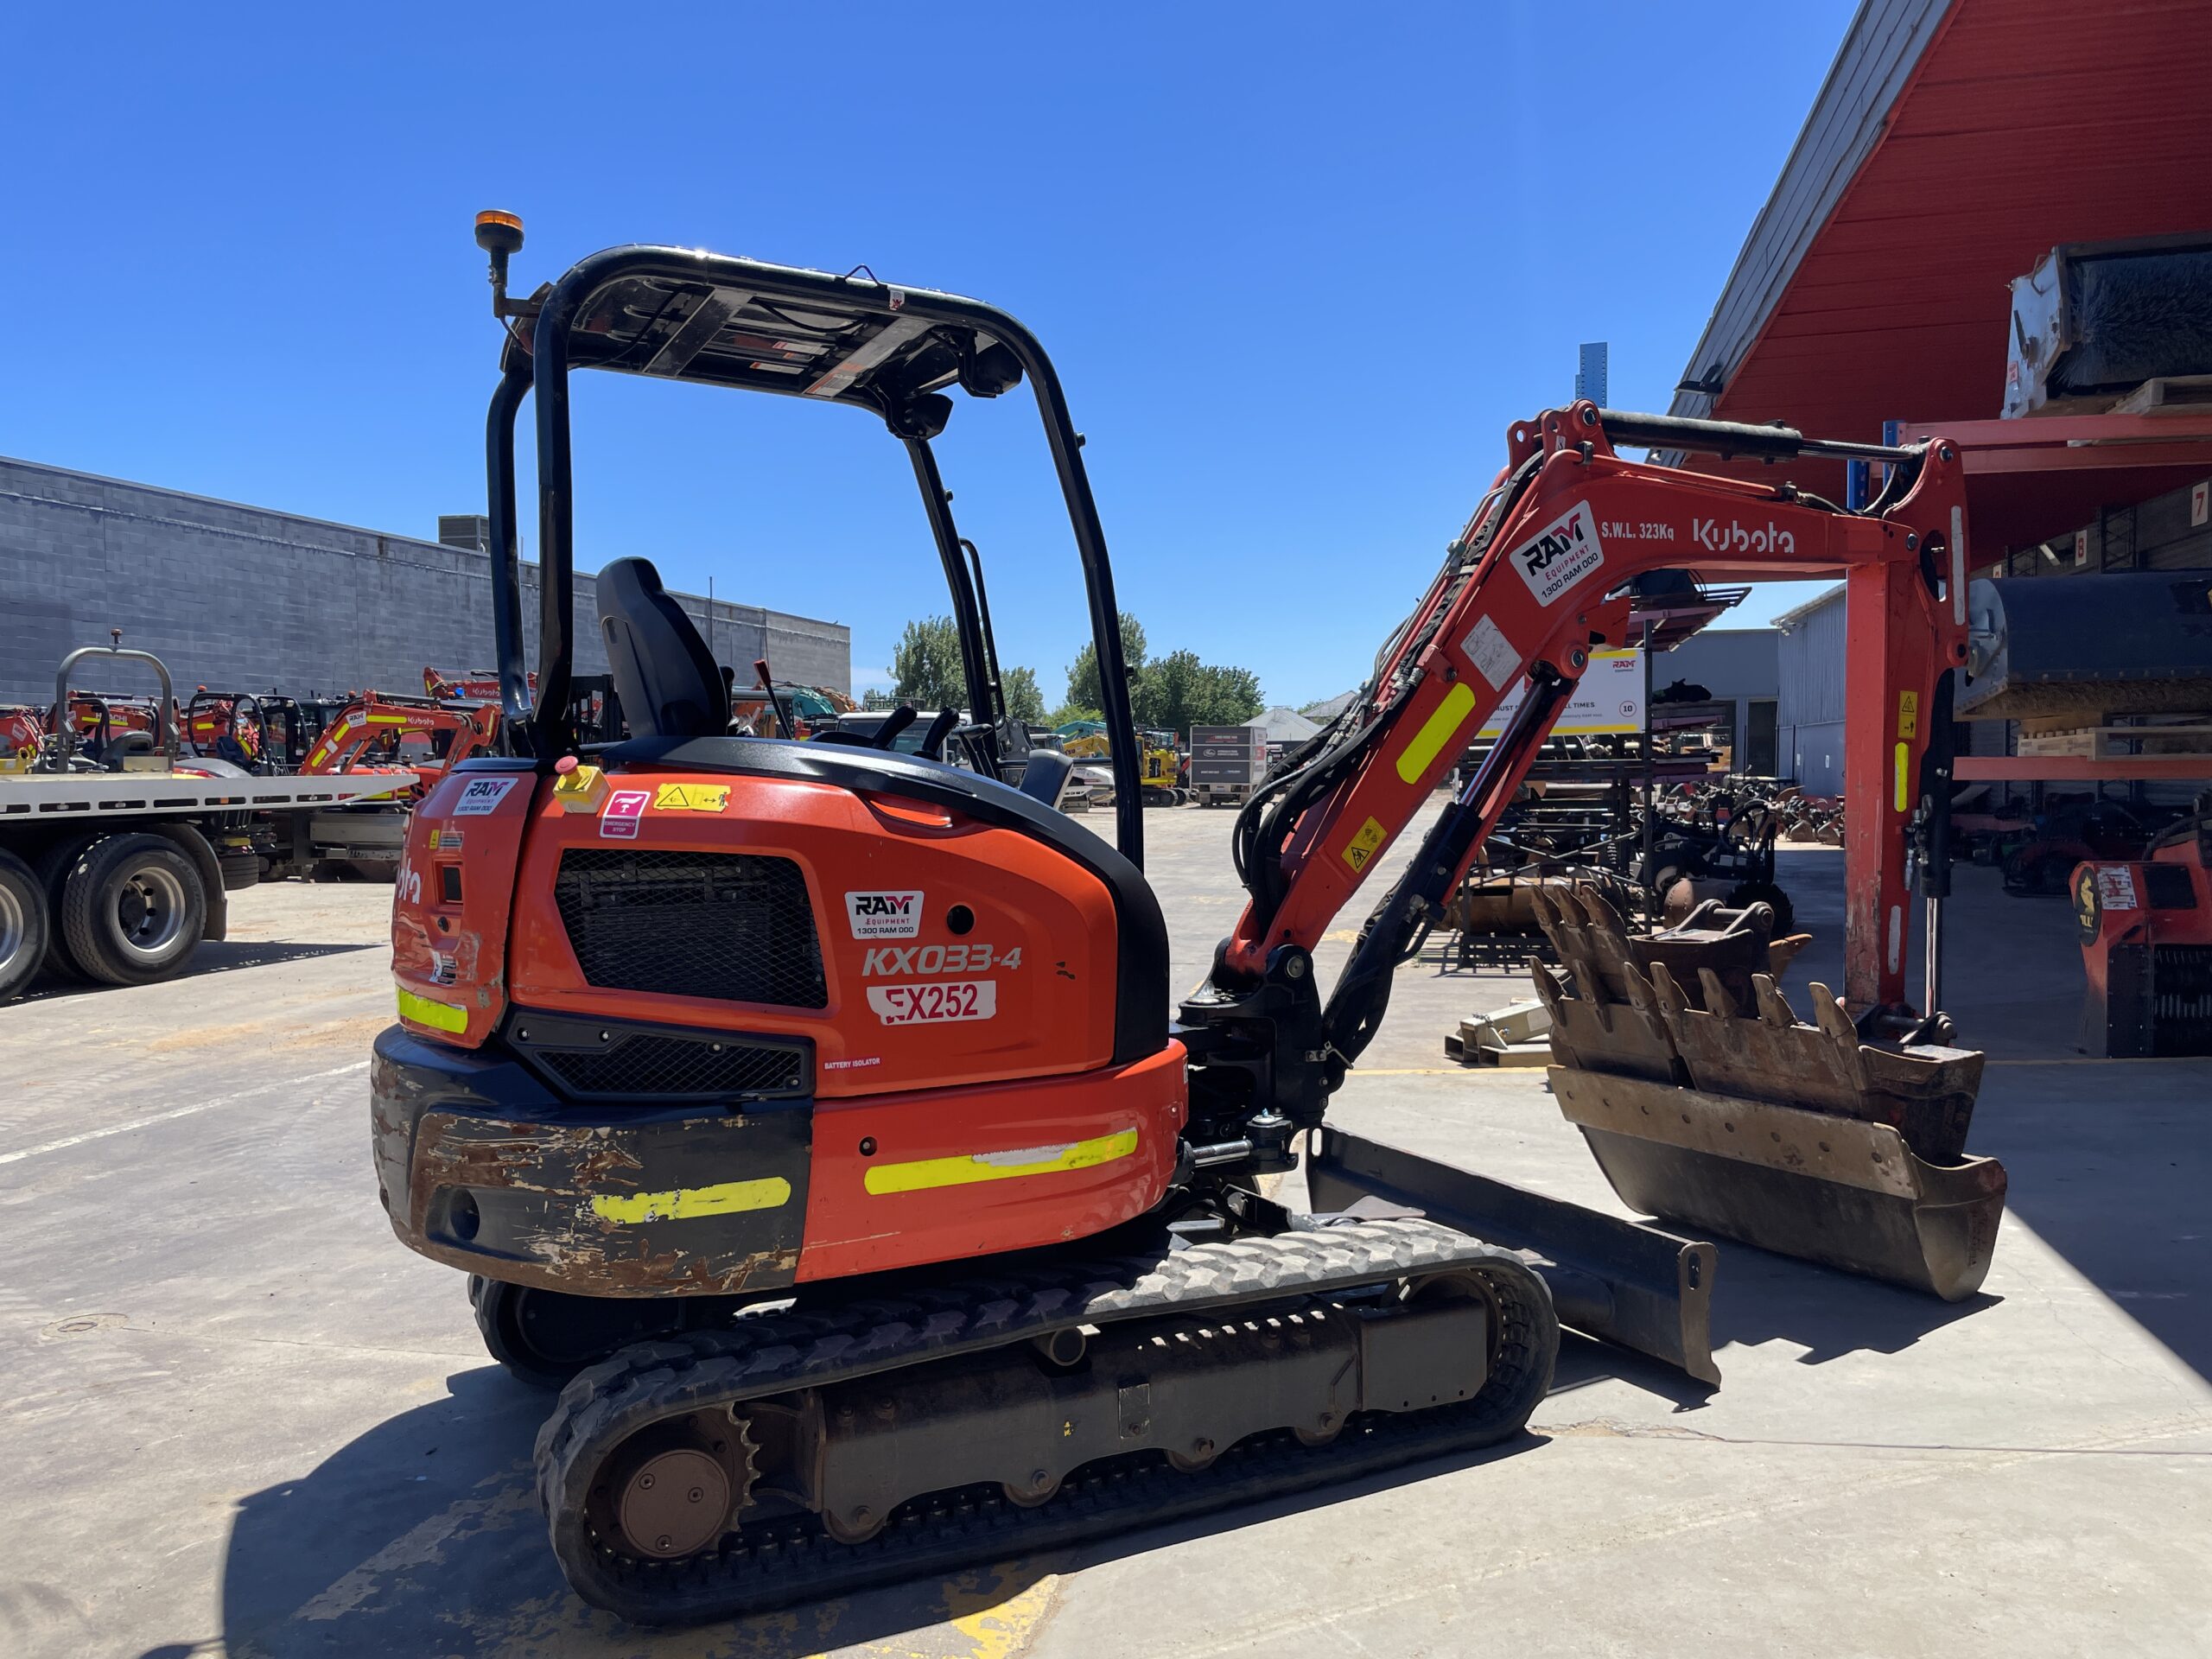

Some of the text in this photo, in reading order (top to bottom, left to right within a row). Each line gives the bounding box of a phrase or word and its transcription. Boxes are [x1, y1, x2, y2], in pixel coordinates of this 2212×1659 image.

[2196, 492, 2205, 517] 7
[1601, 521, 1637, 538] S.W.L.
[1693, 518, 1795, 553] Kubota
[1521, 512, 1585, 576] RAM
[2077, 537, 2084, 558] 8
[1545, 544, 1590, 581] EQUIPMENT
[1541, 552, 1599, 598] 1300 RAM 000
[1612, 659, 1637, 668] RAM
[472, 688, 500, 696] Kubota
[408, 716, 435, 726] Kubota
[466, 781, 510, 797] RAM
[855, 895, 915, 915] RAM
[861, 944, 1022, 976] KX033-4
[824, 1057, 880, 1070] BATTERY ISOLATOR
